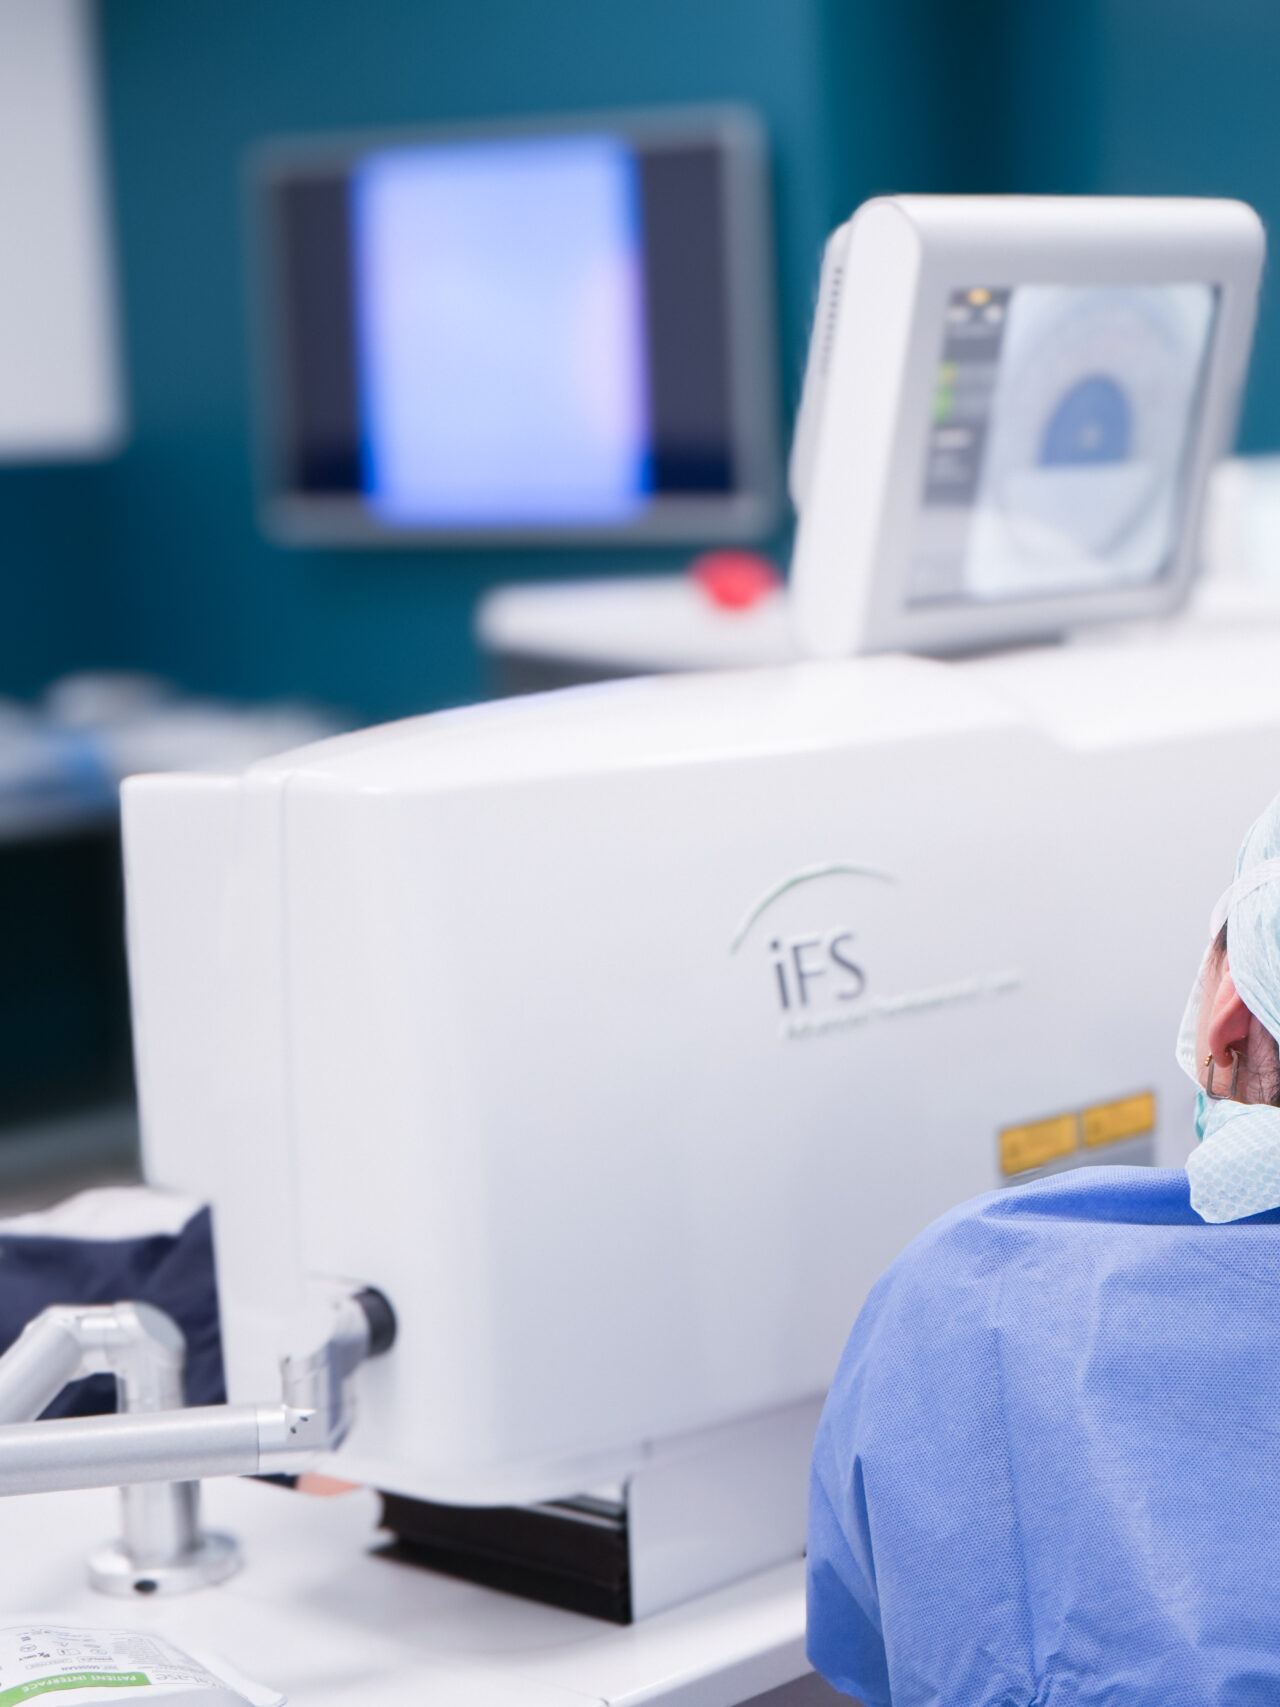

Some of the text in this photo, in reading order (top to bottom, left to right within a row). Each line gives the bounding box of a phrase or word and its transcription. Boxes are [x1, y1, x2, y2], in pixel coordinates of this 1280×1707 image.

[769, 932, 866, 1010] iFS
[23, 1674, 137, 1692] PATIENT INTERFACE
